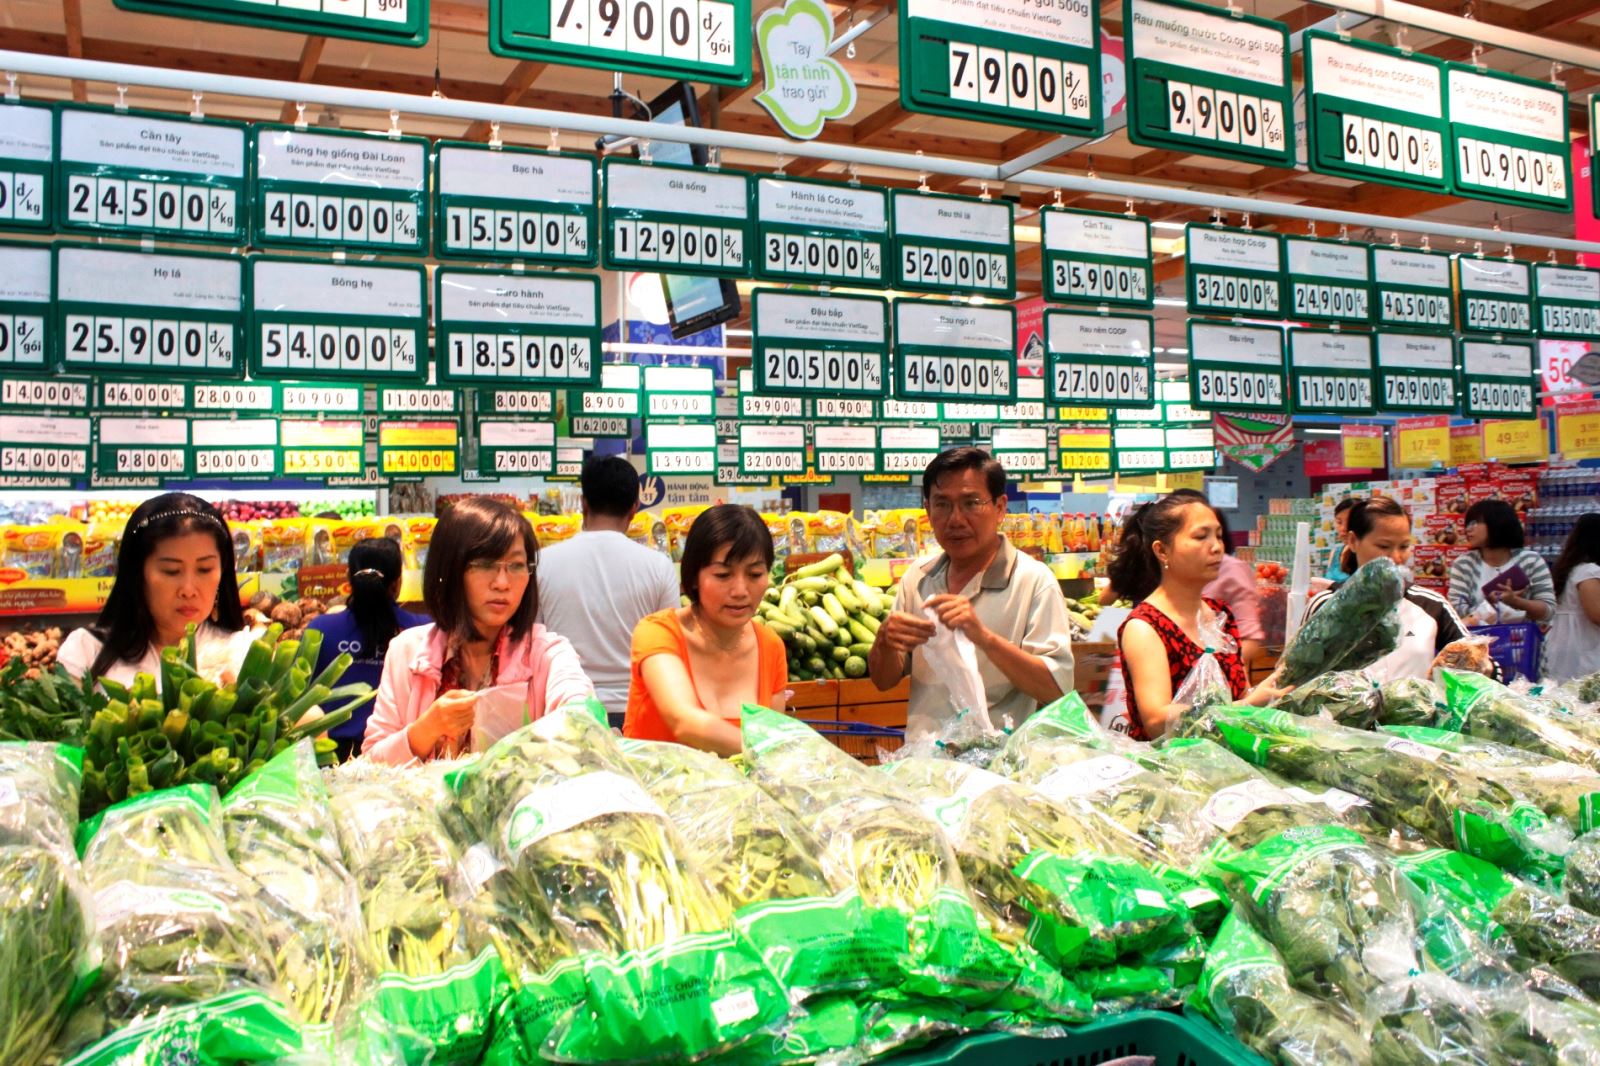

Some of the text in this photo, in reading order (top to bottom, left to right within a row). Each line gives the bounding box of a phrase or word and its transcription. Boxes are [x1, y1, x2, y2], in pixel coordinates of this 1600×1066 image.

[1032, 11, 1062, 27] VietGap
[1133, 12, 1153, 27] Rau
[1155, 20, 1189, 38] muống
[1220, 32, 1246, 49] Co.op
[1248, 38, 1263, 52] gói
[776, 66, 830, 84] tận tình
[952, 50, 1055, 104] 7.900
[782, 87, 805, 101] trao
[1172, 90, 1257, 137] 9.900
[140, 129, 182, 145] Cần tây
[1346, 123, 1418, 165] 6.000
[286, 144, 405, 165] Bông hẹ giống Đài Loan
[1463, 145, 1543, 186] 10.900
[512, 164, 544, 177] Bạc hà
[668, 179, 707, 196] Giá sống
[790, 190, 855, 208] Hành lá Co.op
[73, 183, 204, 222] 24.500
[270, 200, 388, 234] 40.000
[452, 214, 559, 246] 15.500
[619, 226, 717, 258] 12.900
[768, 238, 858, 269] 39.000
[154, 267, 182, 281] Hẹ lá
[905, 251, 986, 281] 52.000
[331, 277, 373, 291] Bông hẹ
[1055, 264, 1128, 292] 35.900
[520, 288, 544, 300] hành
[1198, 278, 1262, 305] 32.000
[1296, 287, 1353, 313] 24.900
[810, 306, 843, 321] Đậu bắp
[1384, 292, 1437, 318] 40.500
[1469, 302, 1518, 325] 22.500
[1544, 308, 1590, 332] 15.500
[72, 321, 201, 357] 25.900
[266, 329, 386, 363] 54.000
[454, 340, 563, 369] 18.500
[768, 353, 859, 382] 20.500
[907, 361, 988, 388] 46.000
[6, 384, 70, 401] 14.000
[1058, 370, 1129, 393] 27.000
[1201, 374, 1265, 399] 30.500
[1302, 380, 1356, 403] 11.900
[1386, 380, 1440, 402] 79.900
[107, 386, 170, 402] 46.000
[386, 393, 440, 407] 11.000
[496, 395, 538, 408] 8.000
[1471, 387, 1519, 407] 34.000
[575, 419, 617, 432] 16.200
[4, 451, 71, 468] 54.000
[119, 453, 169, 468] 9.800
[496, 454, 539, 469] 7.900
